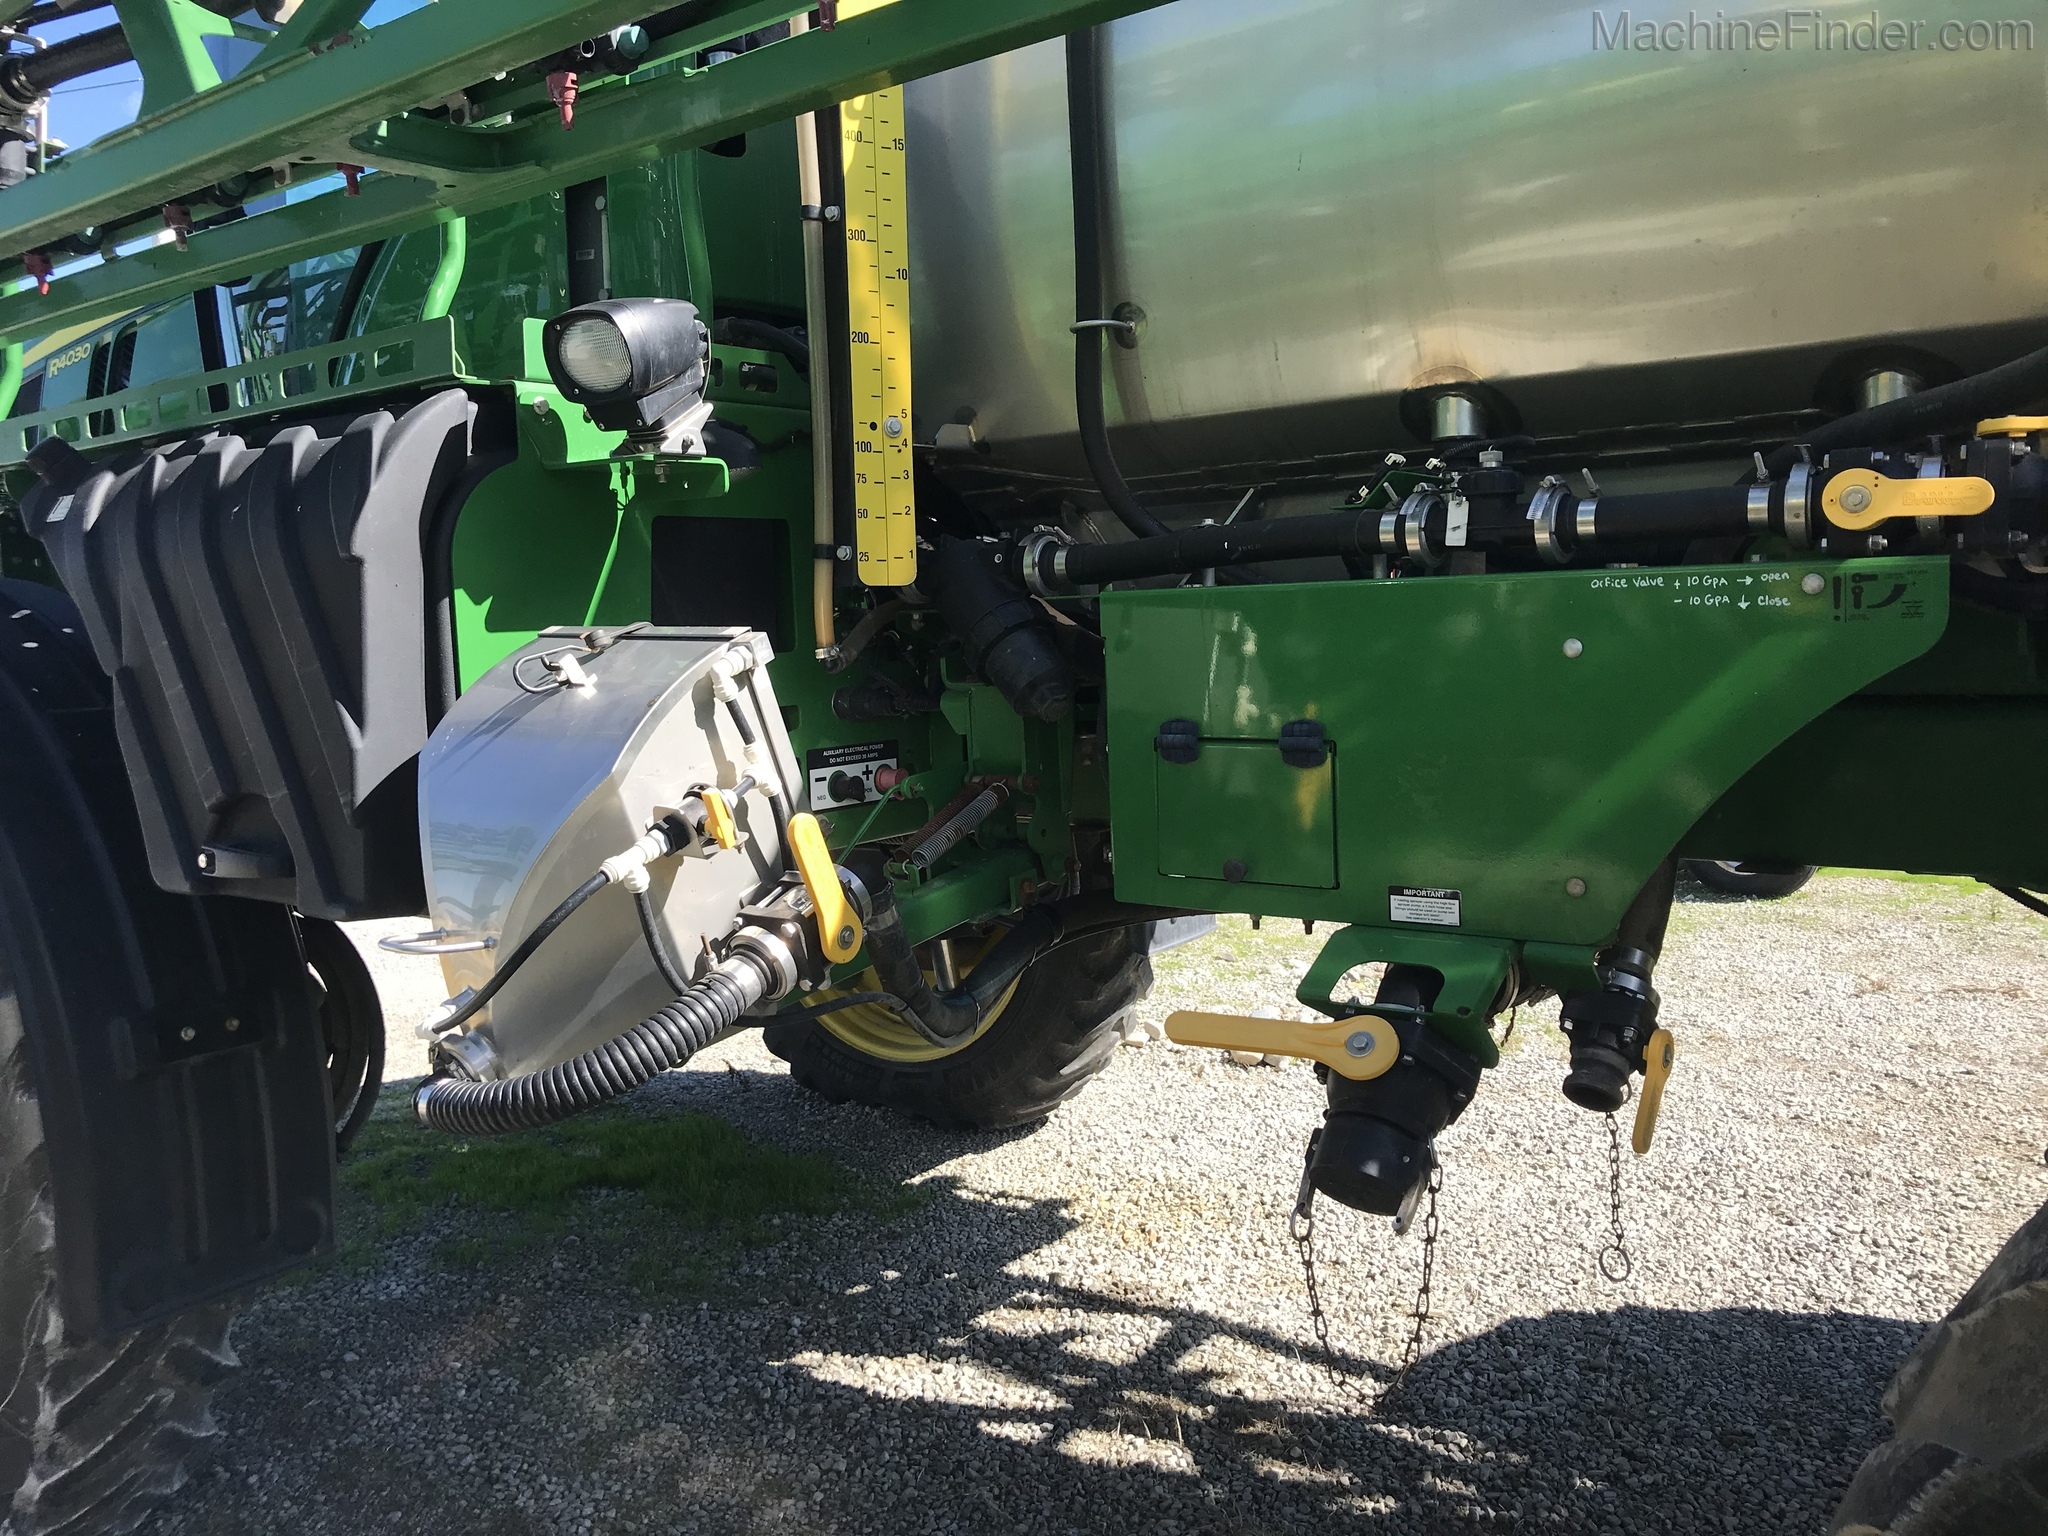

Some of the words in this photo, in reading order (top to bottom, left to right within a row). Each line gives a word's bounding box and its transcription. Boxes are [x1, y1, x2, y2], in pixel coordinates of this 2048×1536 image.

[844, 130, 862, 142] 400
[892, 138, 905, 151] 15
[847, 229, 866, 242] 300
[896, 268, 908, 280] 10
[851, 332, 870, 344] 200
[48, 343, 91, 378] R4030
[901, 409, 908, 419] 5
[855, 442, 871, 453] 100
[901, 438, 908, 448] 4
[857, 473, 866, 484] 75
[903, 470, 910, 480] 3
[858, 508, 868, 518] 50
[904, 506, 910, 516] 2
[859, 552, 869, 562] 25
[909, 550, 914, 559] 1
[1686, 576, 1700, 587] 10
[1689, 595, 1702, 606] 10
[845, 746, 868, 754] ELECTRICAL
[1404, 889, 1446, 898] IMPORTANT
